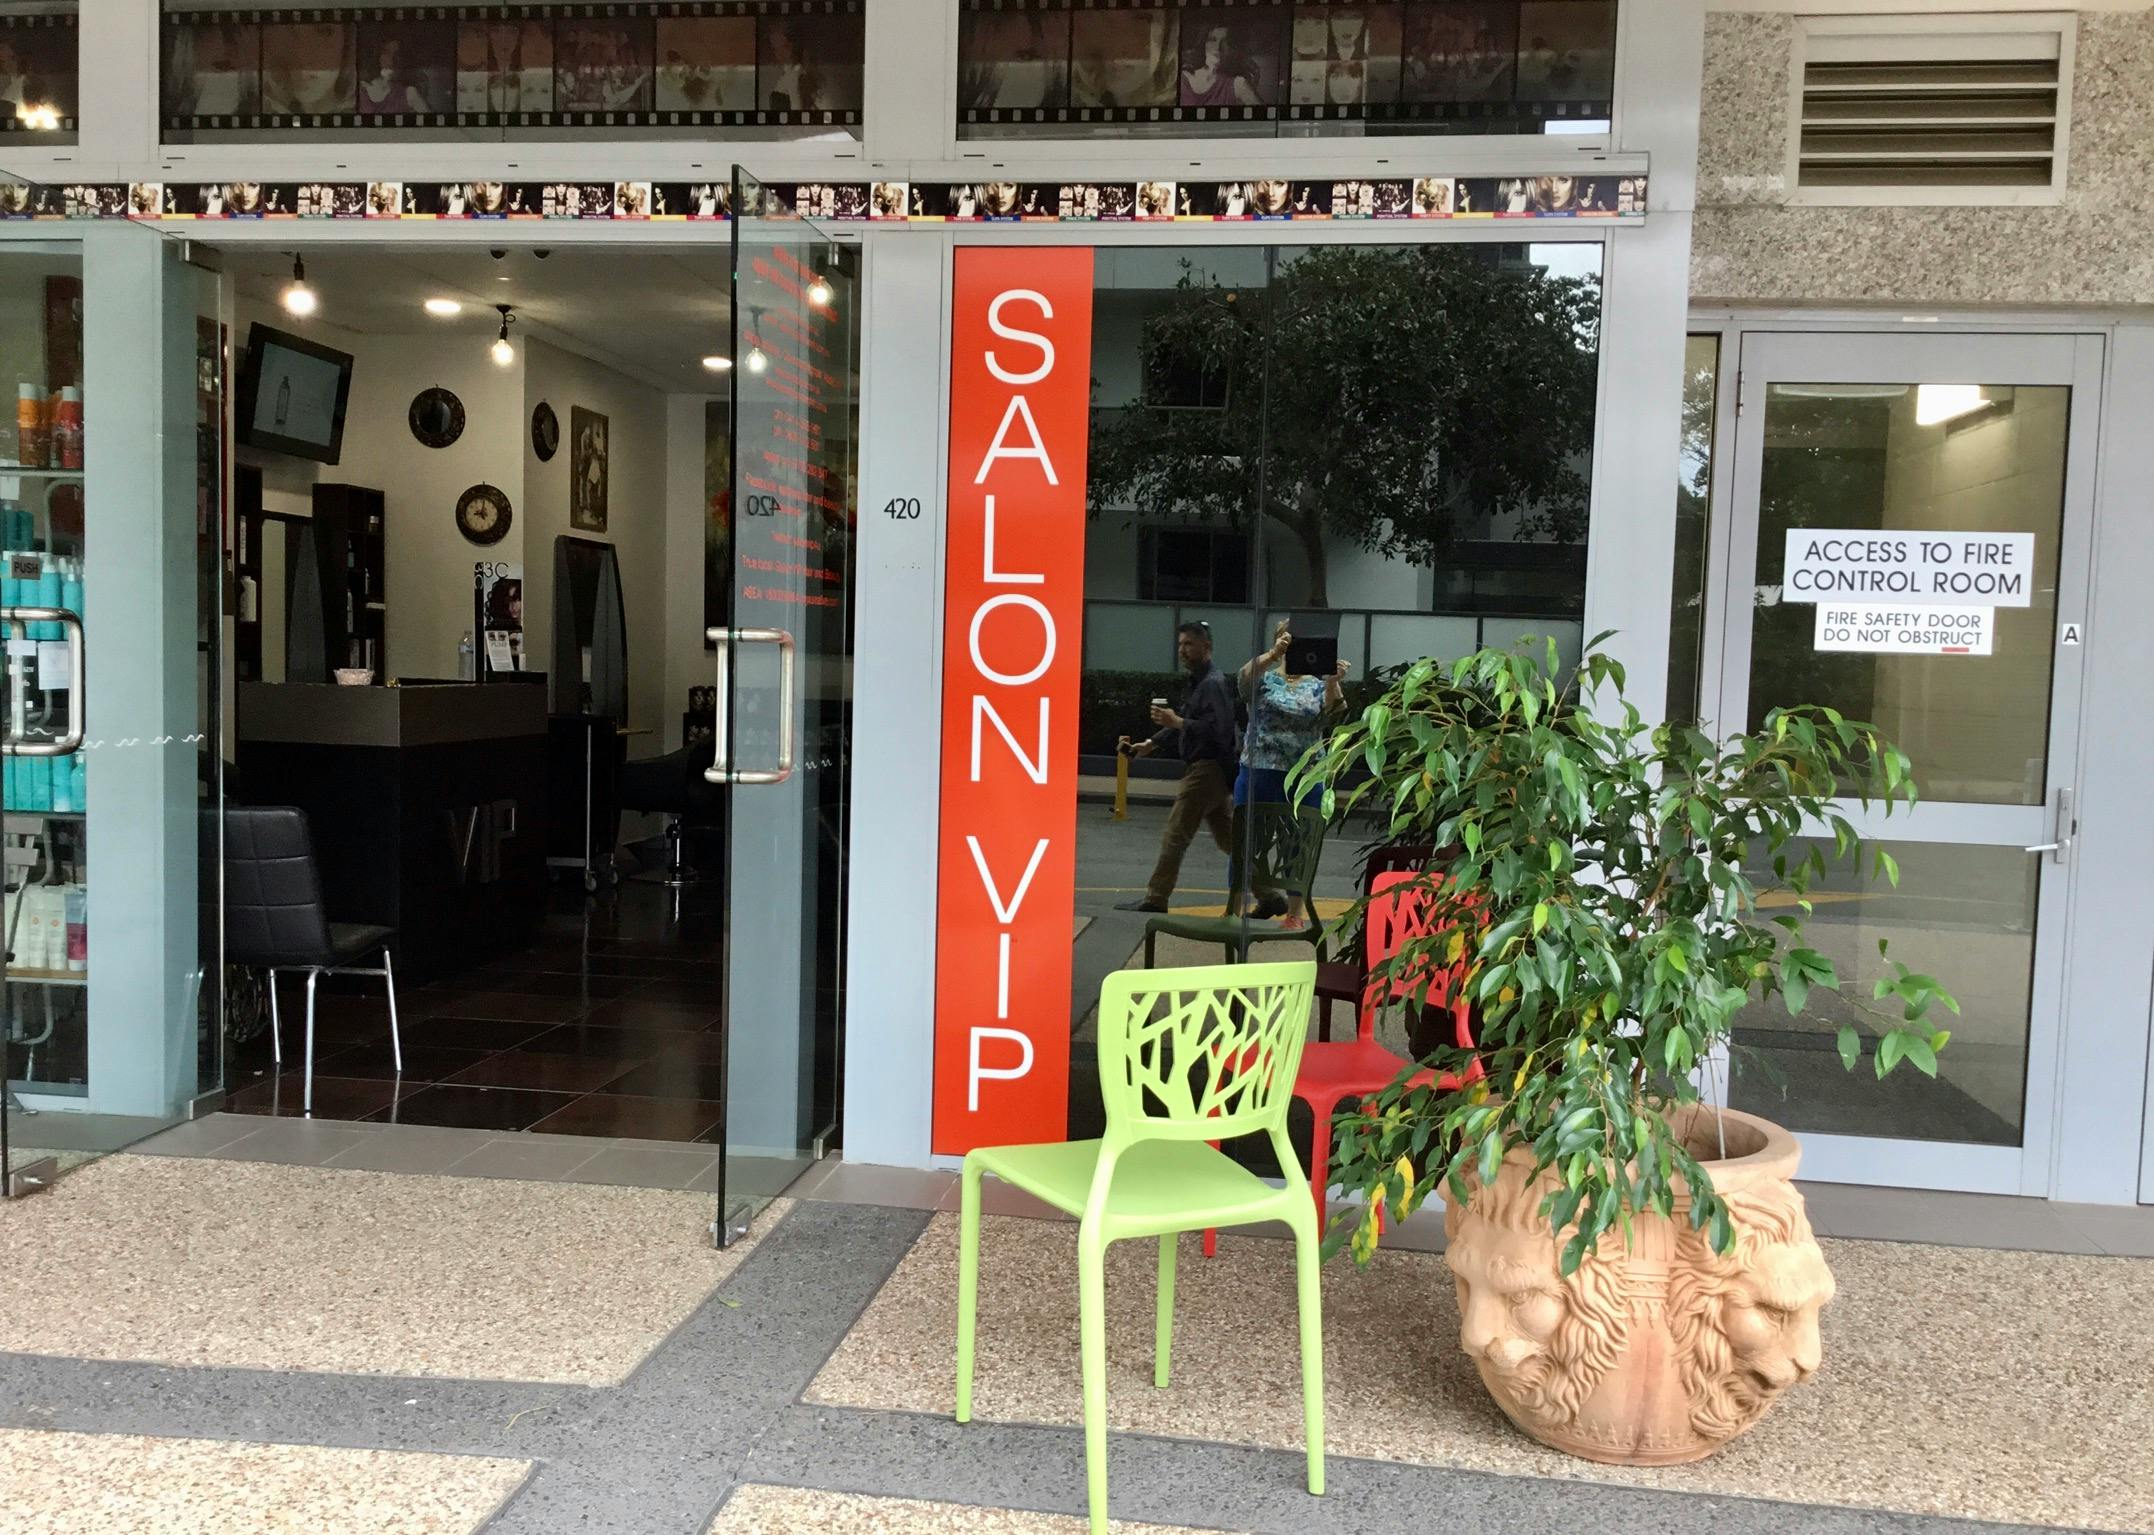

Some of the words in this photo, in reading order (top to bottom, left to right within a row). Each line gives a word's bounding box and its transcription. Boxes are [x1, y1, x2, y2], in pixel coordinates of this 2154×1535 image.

[884, 498, 920, 519] 420
[968, 289, 1059, 785] SALON
[1804, 540, 1907, 563] ACCESS
[1920, 542, 1952, 564] TO
[1964, 543, 2013, 565] FIRE
[14, 561, 39, 575] PUSH
[1792, 569, 1921, 593] CONTROL
[1933, 572, 2021, 594] ROOM
[1827, 611, 1857, 625] FIRE
[1864, 612, 1921, 626] SAFETY
[1928, 614, 1981, 628] DOOR
[1824, 628, 1850, 642] DO
[1857, 629, 1890, 643] NOT
[1898, 630, 1982, 645] OBSTRUCT
[2064, 626, 2078, 642] A
[965, 835, 1050, 1112] VIP
